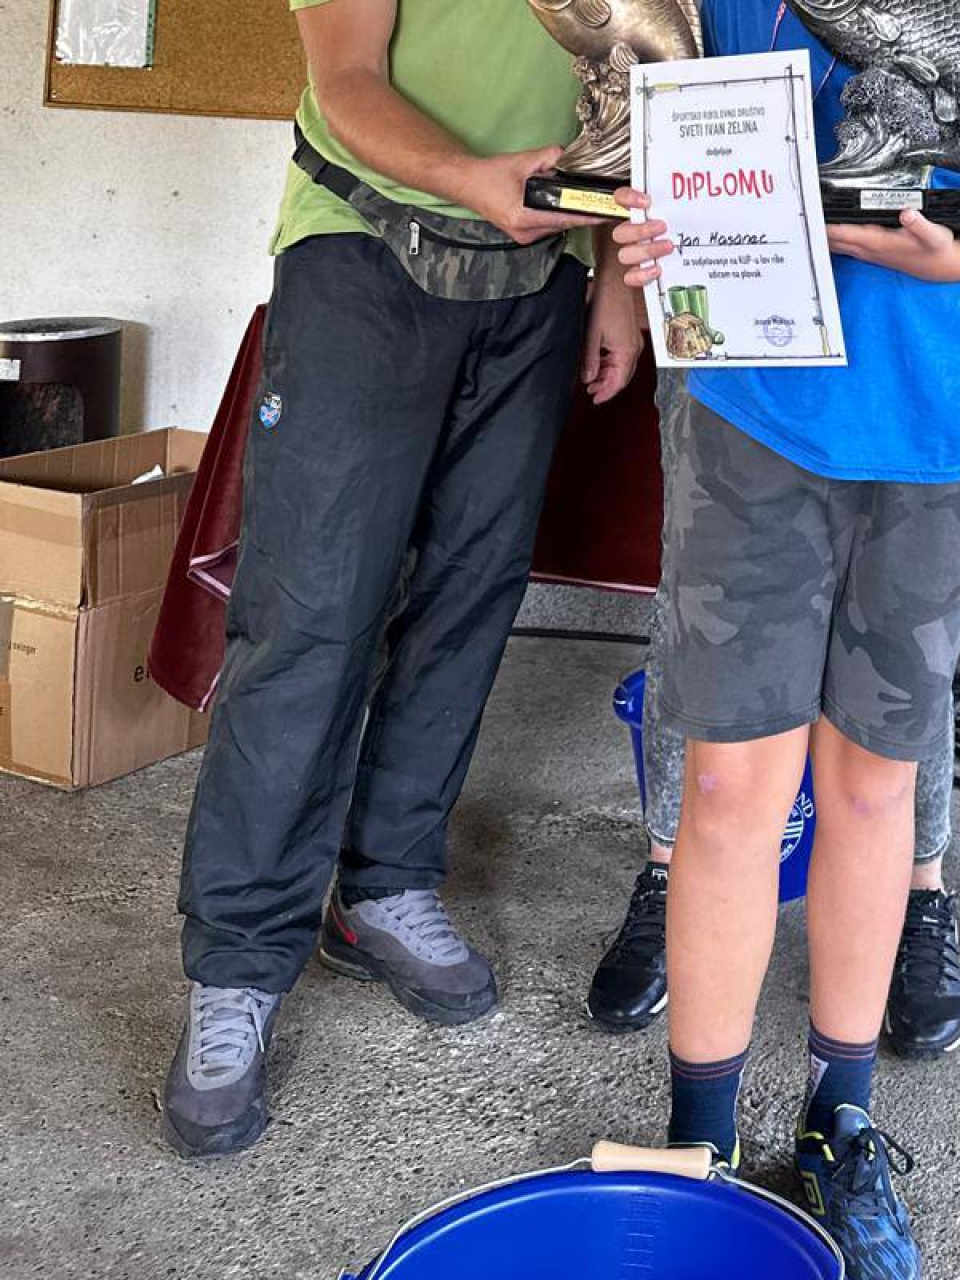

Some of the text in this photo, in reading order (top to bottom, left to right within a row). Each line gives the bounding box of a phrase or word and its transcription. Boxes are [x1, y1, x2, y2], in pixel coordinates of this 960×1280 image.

[679, 120, 758, 138] SVETI IVAN ZELINA
[672, 168, 774, 200] DIPLOMU
[677, 232, 699, 255] Jan
